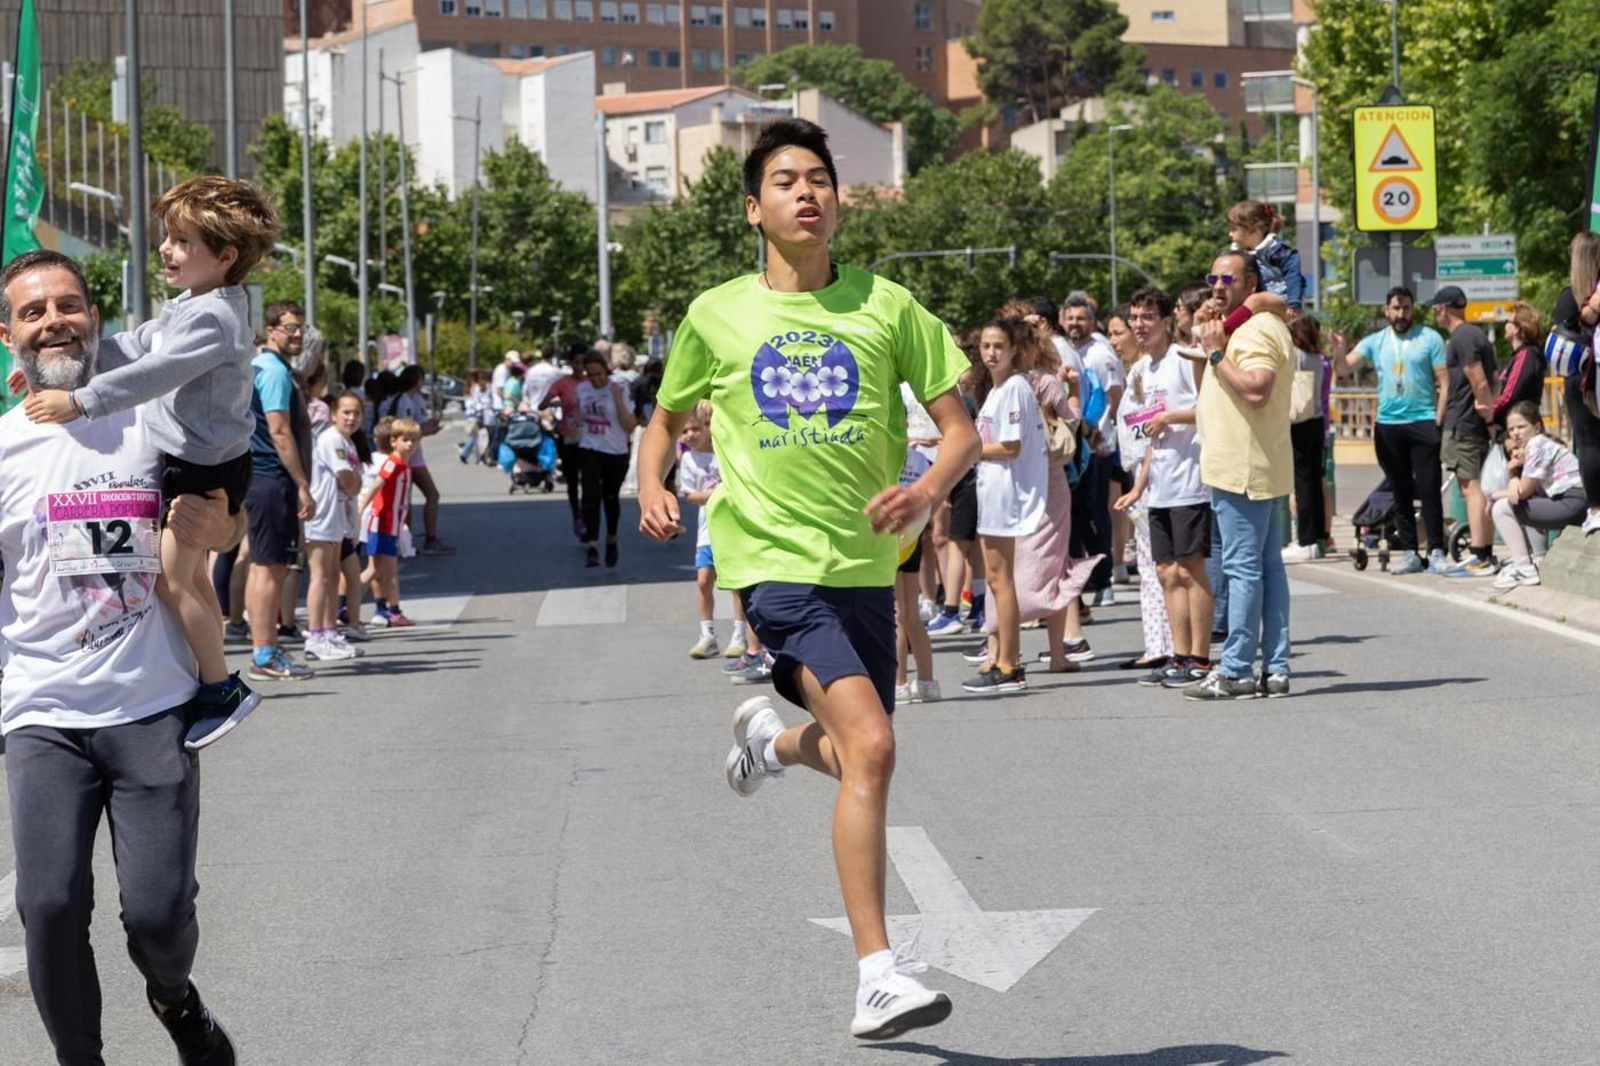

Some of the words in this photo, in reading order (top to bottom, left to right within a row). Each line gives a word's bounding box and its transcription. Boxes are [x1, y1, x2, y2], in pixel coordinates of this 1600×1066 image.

[1358, 110, 1431, 122] ATENCION
[1383, 191, 1410, 206] 20
[769, 330, 835, 349] 2023
[785, 354, 822, 368] JAÉN
[73, 471, 116, 490] XXVII
[53, 492, 97, 507] XXVII
[54, 504, 107, 520] CARRERA
[86, 519, 134, 555] 12
